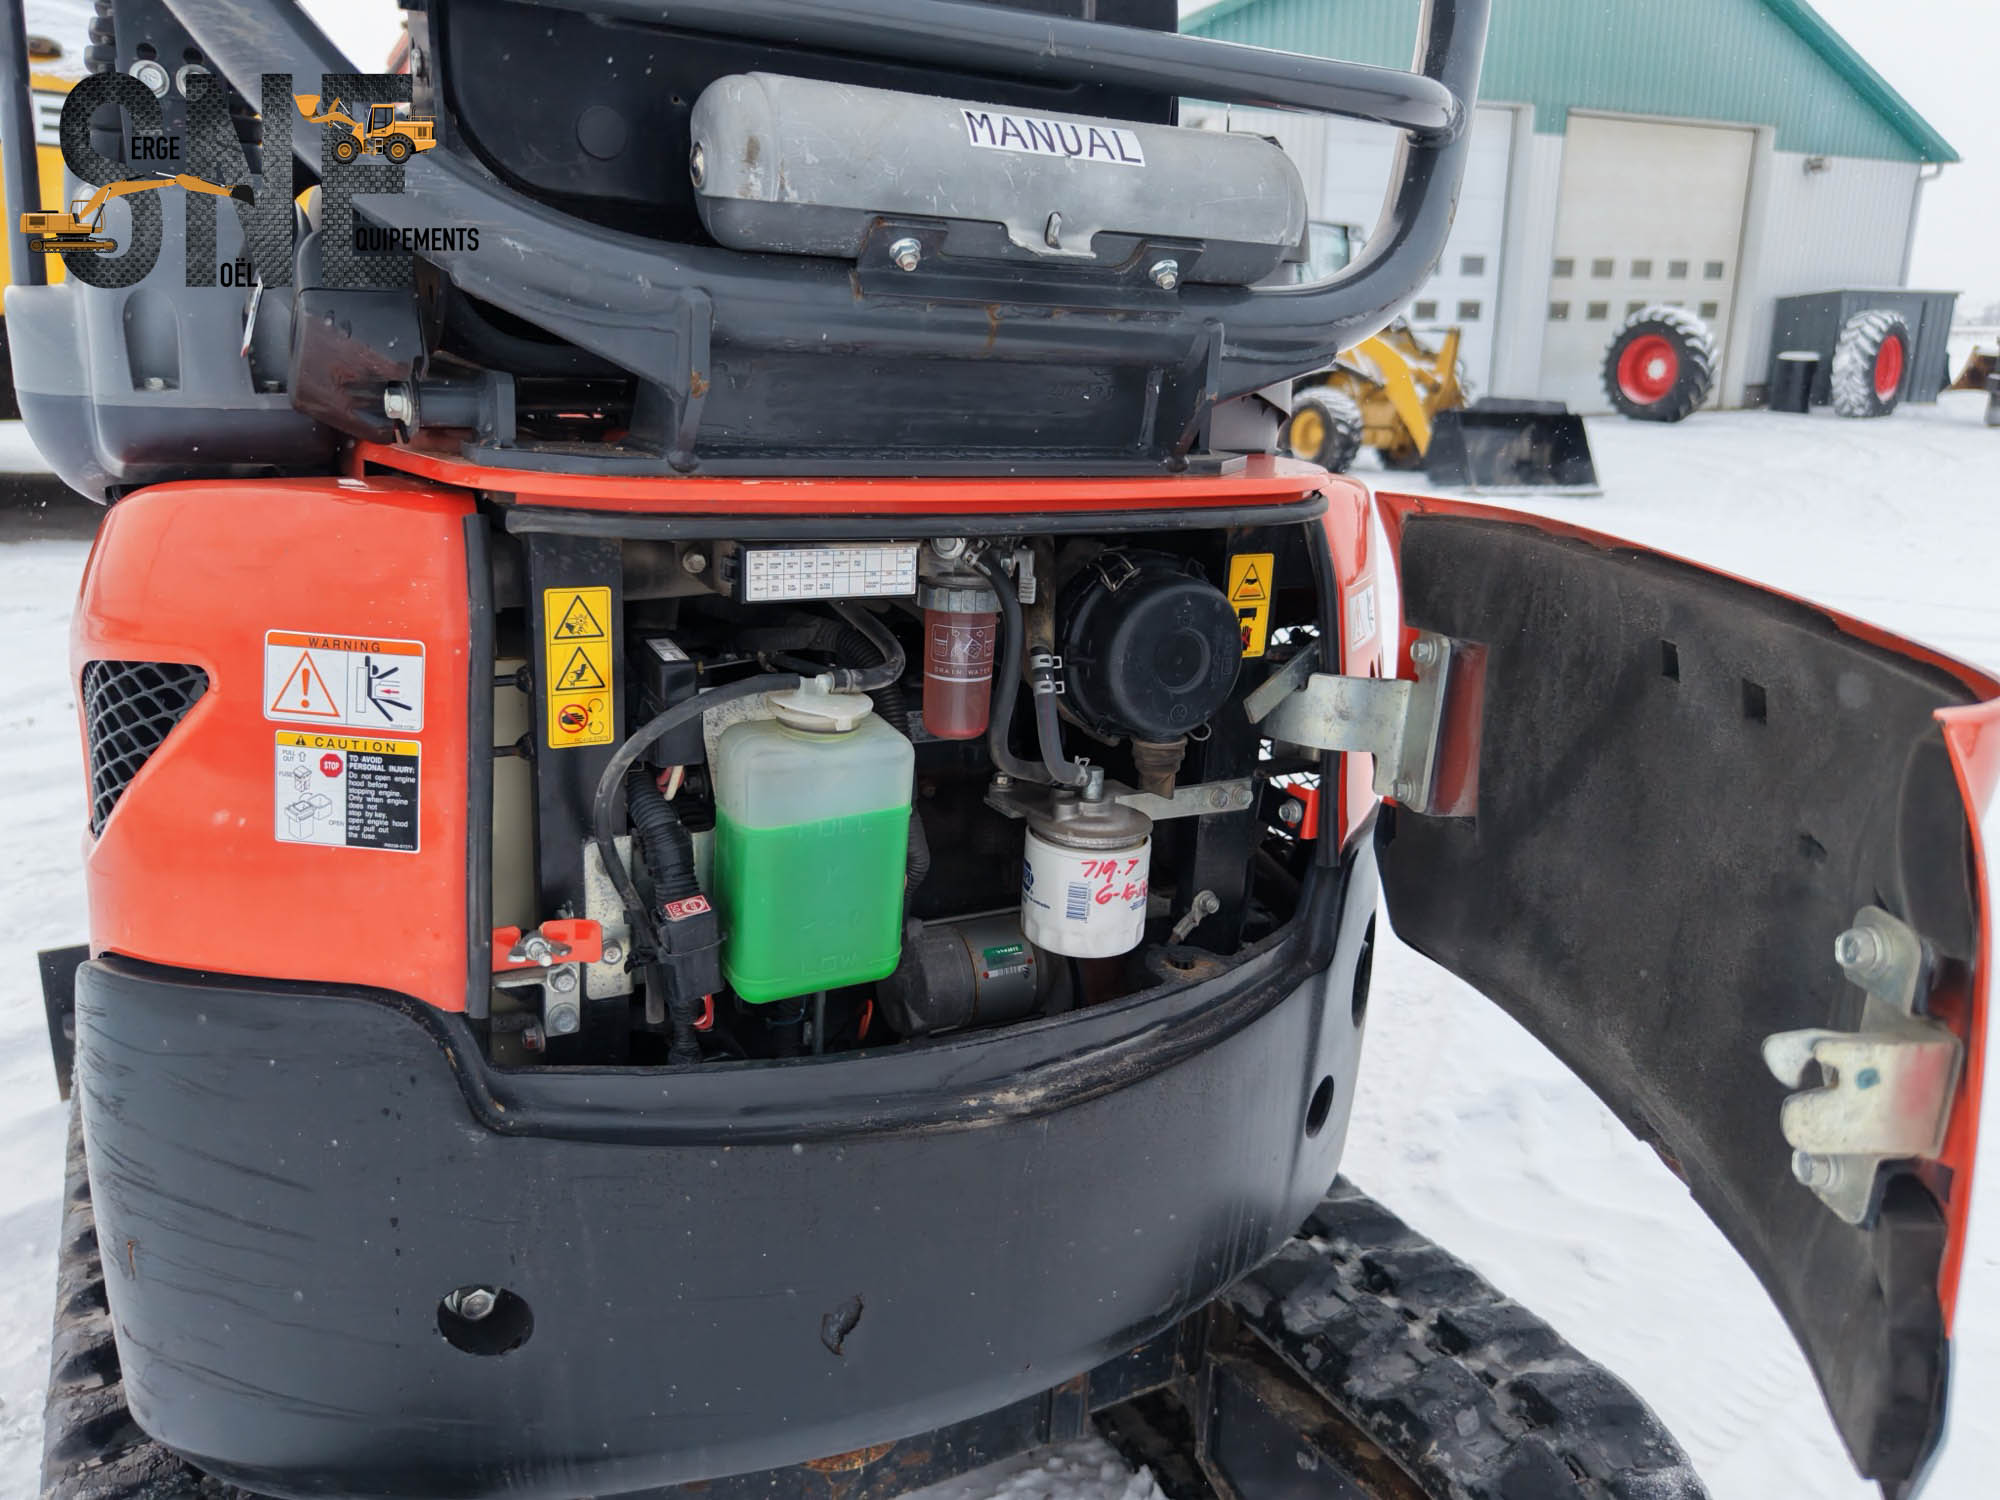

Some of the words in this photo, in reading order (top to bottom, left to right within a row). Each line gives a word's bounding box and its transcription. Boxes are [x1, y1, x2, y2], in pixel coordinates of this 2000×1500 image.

[964, 111, 1142, 163] MANUAL
[308, 636, 381, 653] WARNING
[314, 736, 396, 753] CAUTION
[348, 754, 359, 762] TO
[361, 755, 383, 764] AVOID
[323, 760, 340, 771] STOP
[349, 762, 386, 772] PERSONAL
[388, 764, 415, 774] INJURY:
[348, 771, 358, 779] Do
[394, 776, 416, 785] engine
[367, 781, 388, 789] before
[348, 787, 376, 797] stopping
[387, 798, 409, 806] engine
[367, 819, 389, 827] engine
[391, 820, 409, 828] hood
[363, 825, 376, 833] pull
